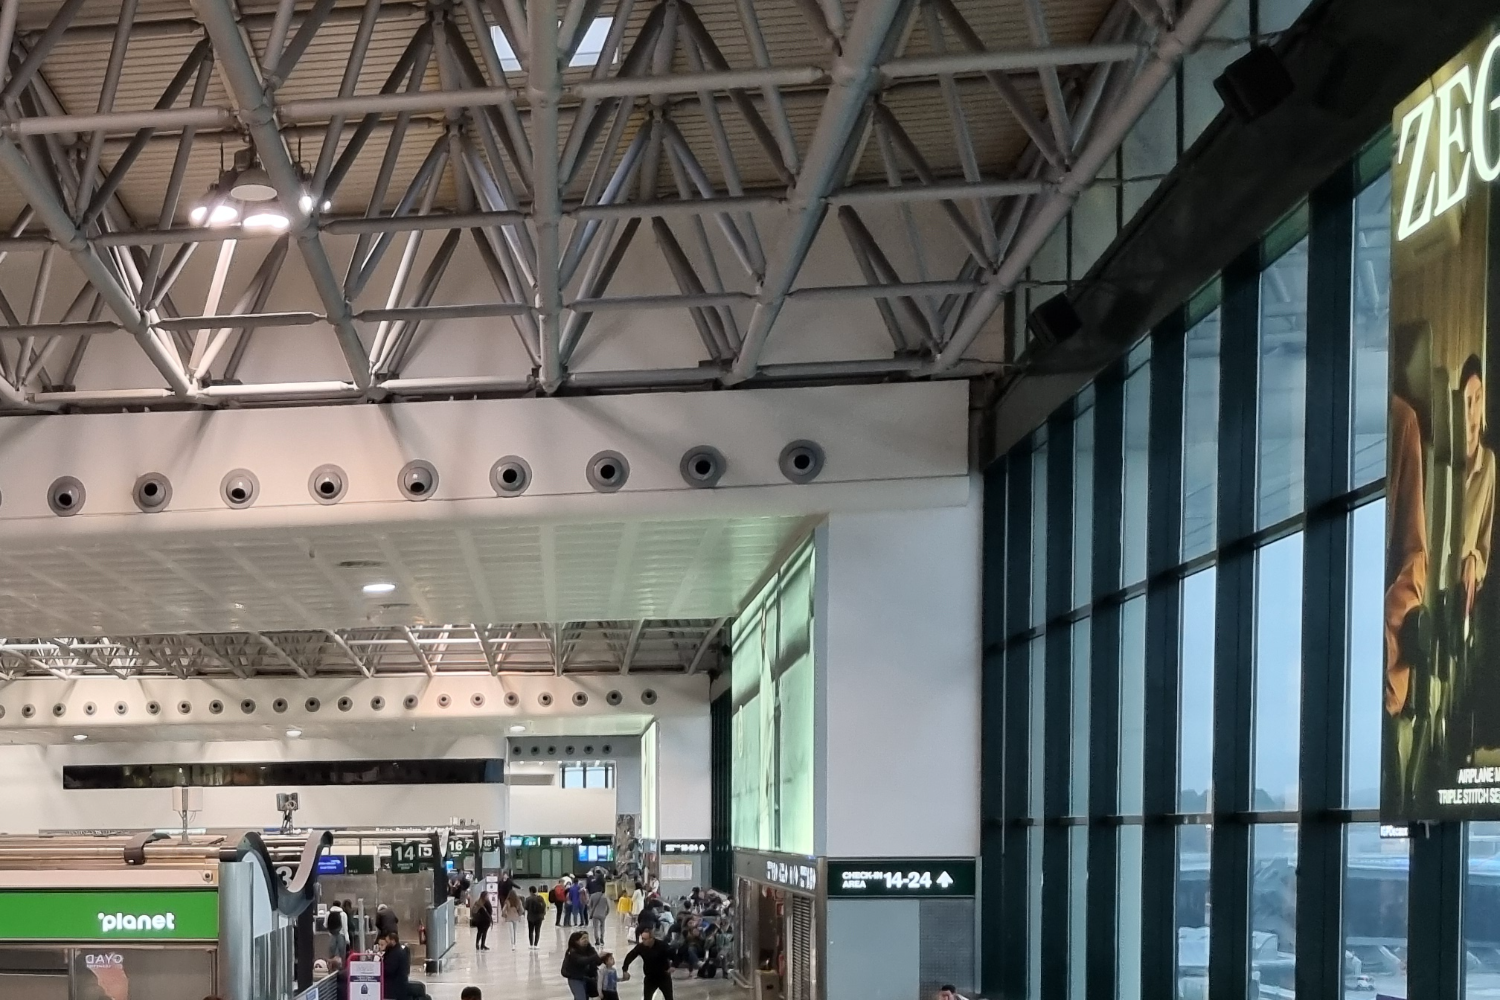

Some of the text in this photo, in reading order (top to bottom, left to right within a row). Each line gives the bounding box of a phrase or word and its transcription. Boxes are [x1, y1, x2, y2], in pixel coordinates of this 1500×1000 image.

[1457, 767, 1494, 784] AIRPLANE
[1438, 789, 1462, 805] TRIPLE
[1463, 788, 1489, 805] STITCH
[394, 845, 414, 862] 14
[449, 840, 463, 852] 16
[842, 871, 932, 889] CHECK-IN 14-24
[842, 880, 867, 889] AREA
[100, 912, 175, 933] planet
